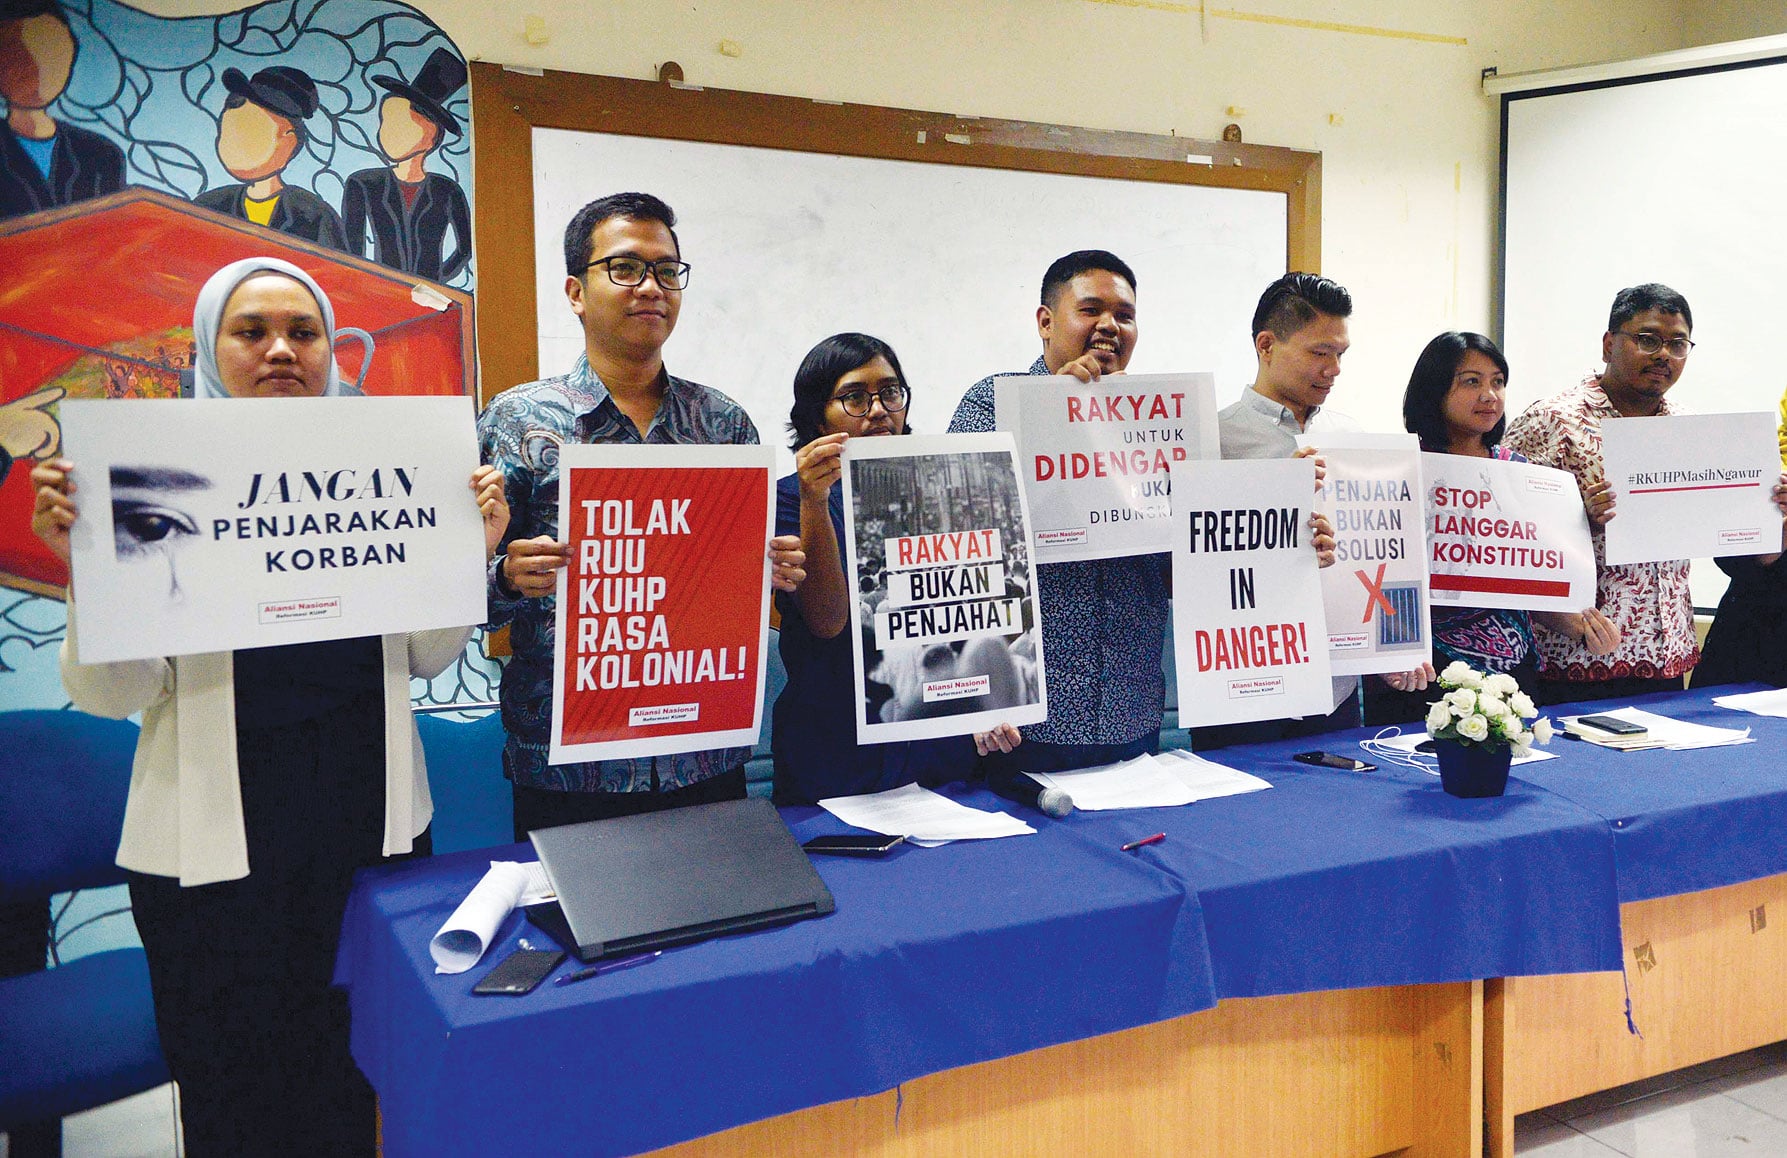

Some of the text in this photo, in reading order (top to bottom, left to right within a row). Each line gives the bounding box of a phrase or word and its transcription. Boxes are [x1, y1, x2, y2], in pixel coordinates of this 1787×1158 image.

[1066, 393, 1185, 423] RAKYAT
[1124, 428, 1184, 443] UNTUK
[238, 467, 418, 509] JANGAN
[1322, 480, 1411, 501] PENJARA
[1628, 468, 1762, 485] #RKUHPMasihNgawur
[1435, 487, 1492, 509] STOP
[213, 507, 437, 541] PENJARAKAN
[581, 499, 691, 536] TOLAK
[1190, 507, 1299, 553] FREEDOM
[1336, 509, 1402, 531] BUKAN
[1434, 514, 1537, 541] LANGGAR
[265, 542, 406, 572] KORBAN
[579, 538, 646, 575] RUU
[898, 529, 994, 566] RAKYAT
[1337, 538, 1405, 560] SOLUSI
[1433, 542, 1564, 570] KONSTITUSI
[578, 576, 666, 615] KUHP
[910, 567, 990, 601] BUKAN
[1229, 567, 1256, 610] IN
[264, 601, 337, 612] Aliansi Nasional
[889, 599, 1014, 640] PENJAHAT
[577, 614, 670, 653] RASA
[1195, 622, 1309, 673] DANGER!
[576, 646, 746, 691] KOLONIAL!
[955, 679, 987, 688] Nasional
[634, 706, 696, 717] Aliansi Nasional
